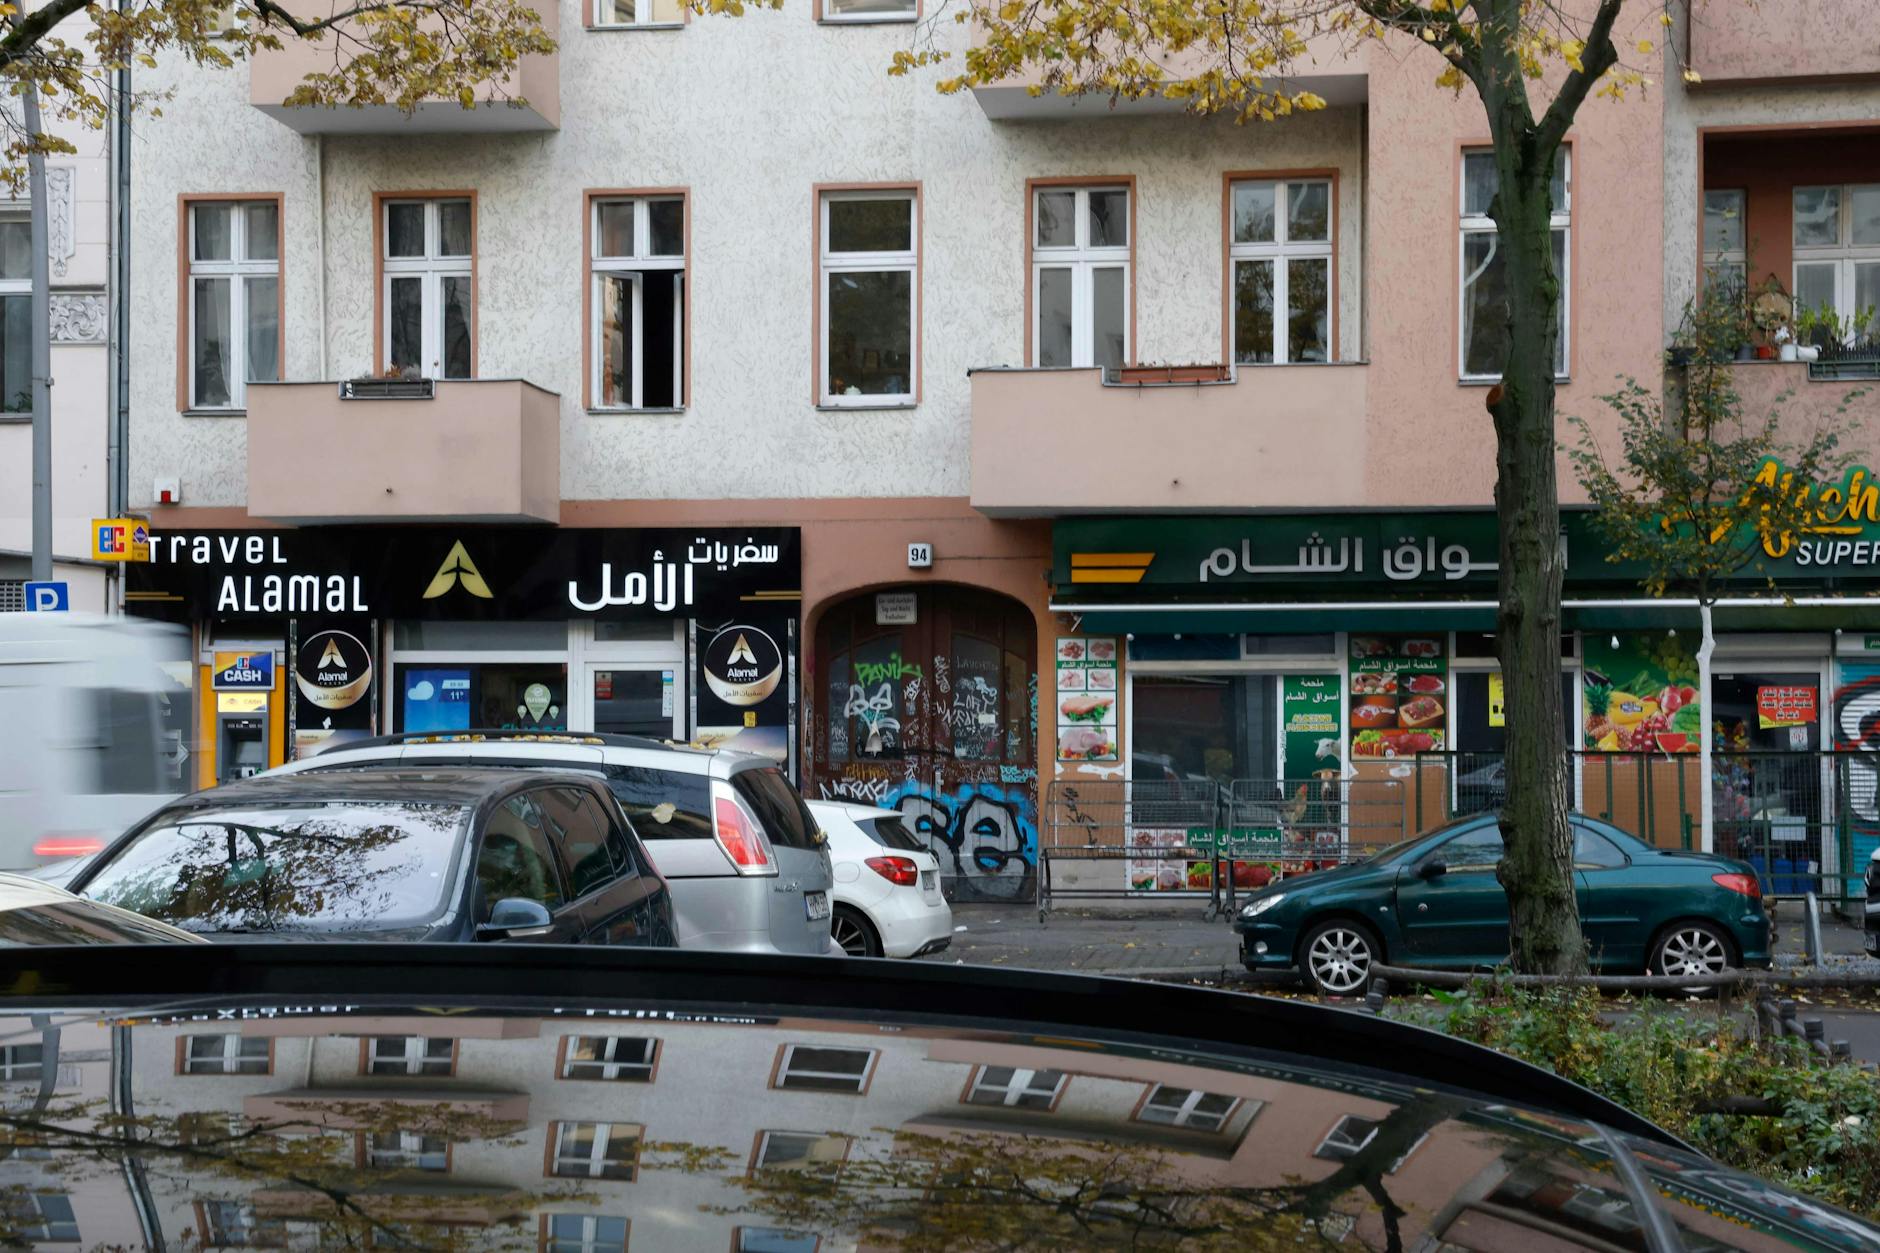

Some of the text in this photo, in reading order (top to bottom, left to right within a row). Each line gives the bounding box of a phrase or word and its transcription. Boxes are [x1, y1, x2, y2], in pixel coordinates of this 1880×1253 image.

[688, 537, 779, 571] سفريات
[910, 549, 928, 562] 94
[1199, 531, 1363, 582] الشام
[568, 549, 694, 612] الأمل
[35, 588, 59, 610] P
[224, 669, 262, 682] CASH
[318, 671, 348, 682] Alamal
[728, 668, 758, 678] Alamal
[1285, 690, 1307, 704] الشام
[1189, 831, 1212, 845] لشام
